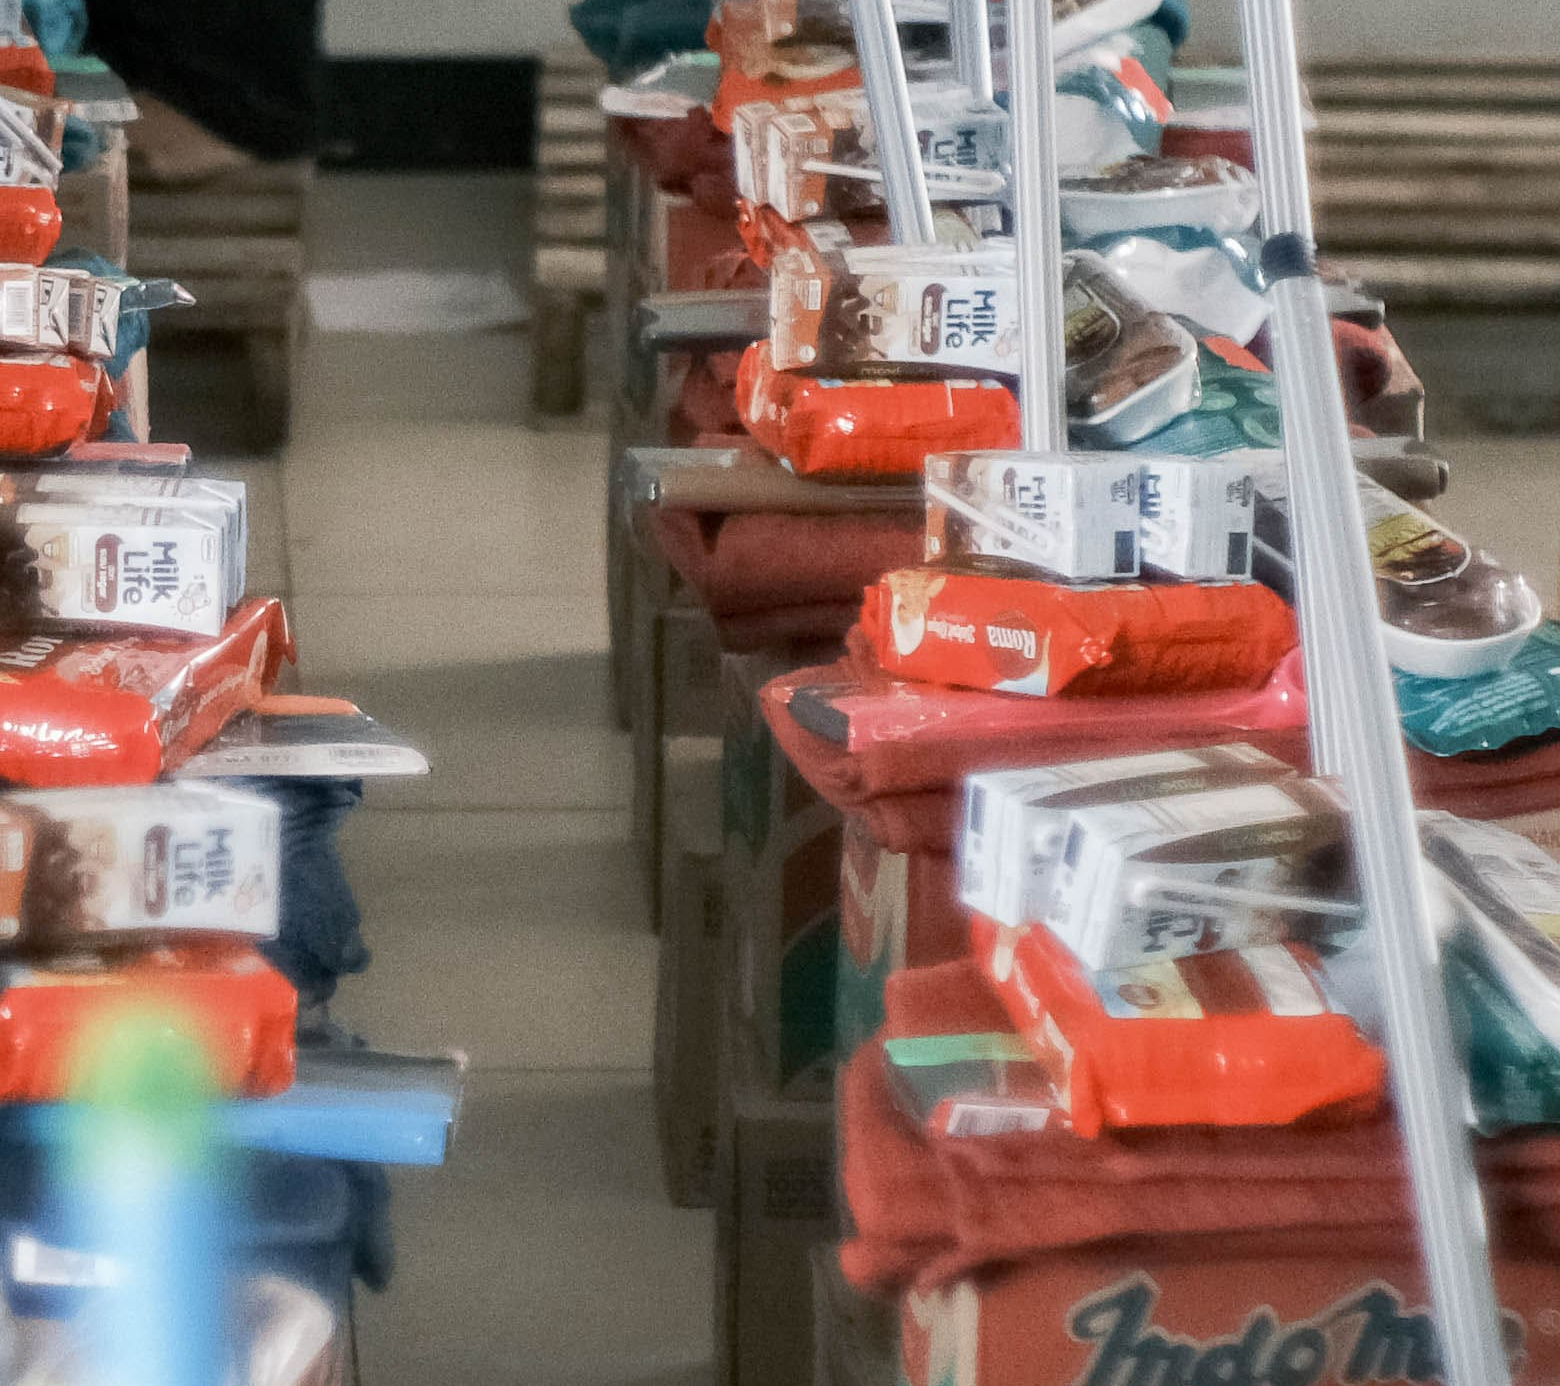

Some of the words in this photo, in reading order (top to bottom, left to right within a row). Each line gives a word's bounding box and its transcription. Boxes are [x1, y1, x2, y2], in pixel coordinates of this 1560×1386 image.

[945, 299, 971, 350] Life
[971, 289, 997, 347] Milk
[122, 550, 150, 606] Life
[152, 540, 180, 604] Milk
[986, 624, 1037, 660] Roma
[174, 842, 201, 907] Life
[205, 828, 233, 901] Milk
